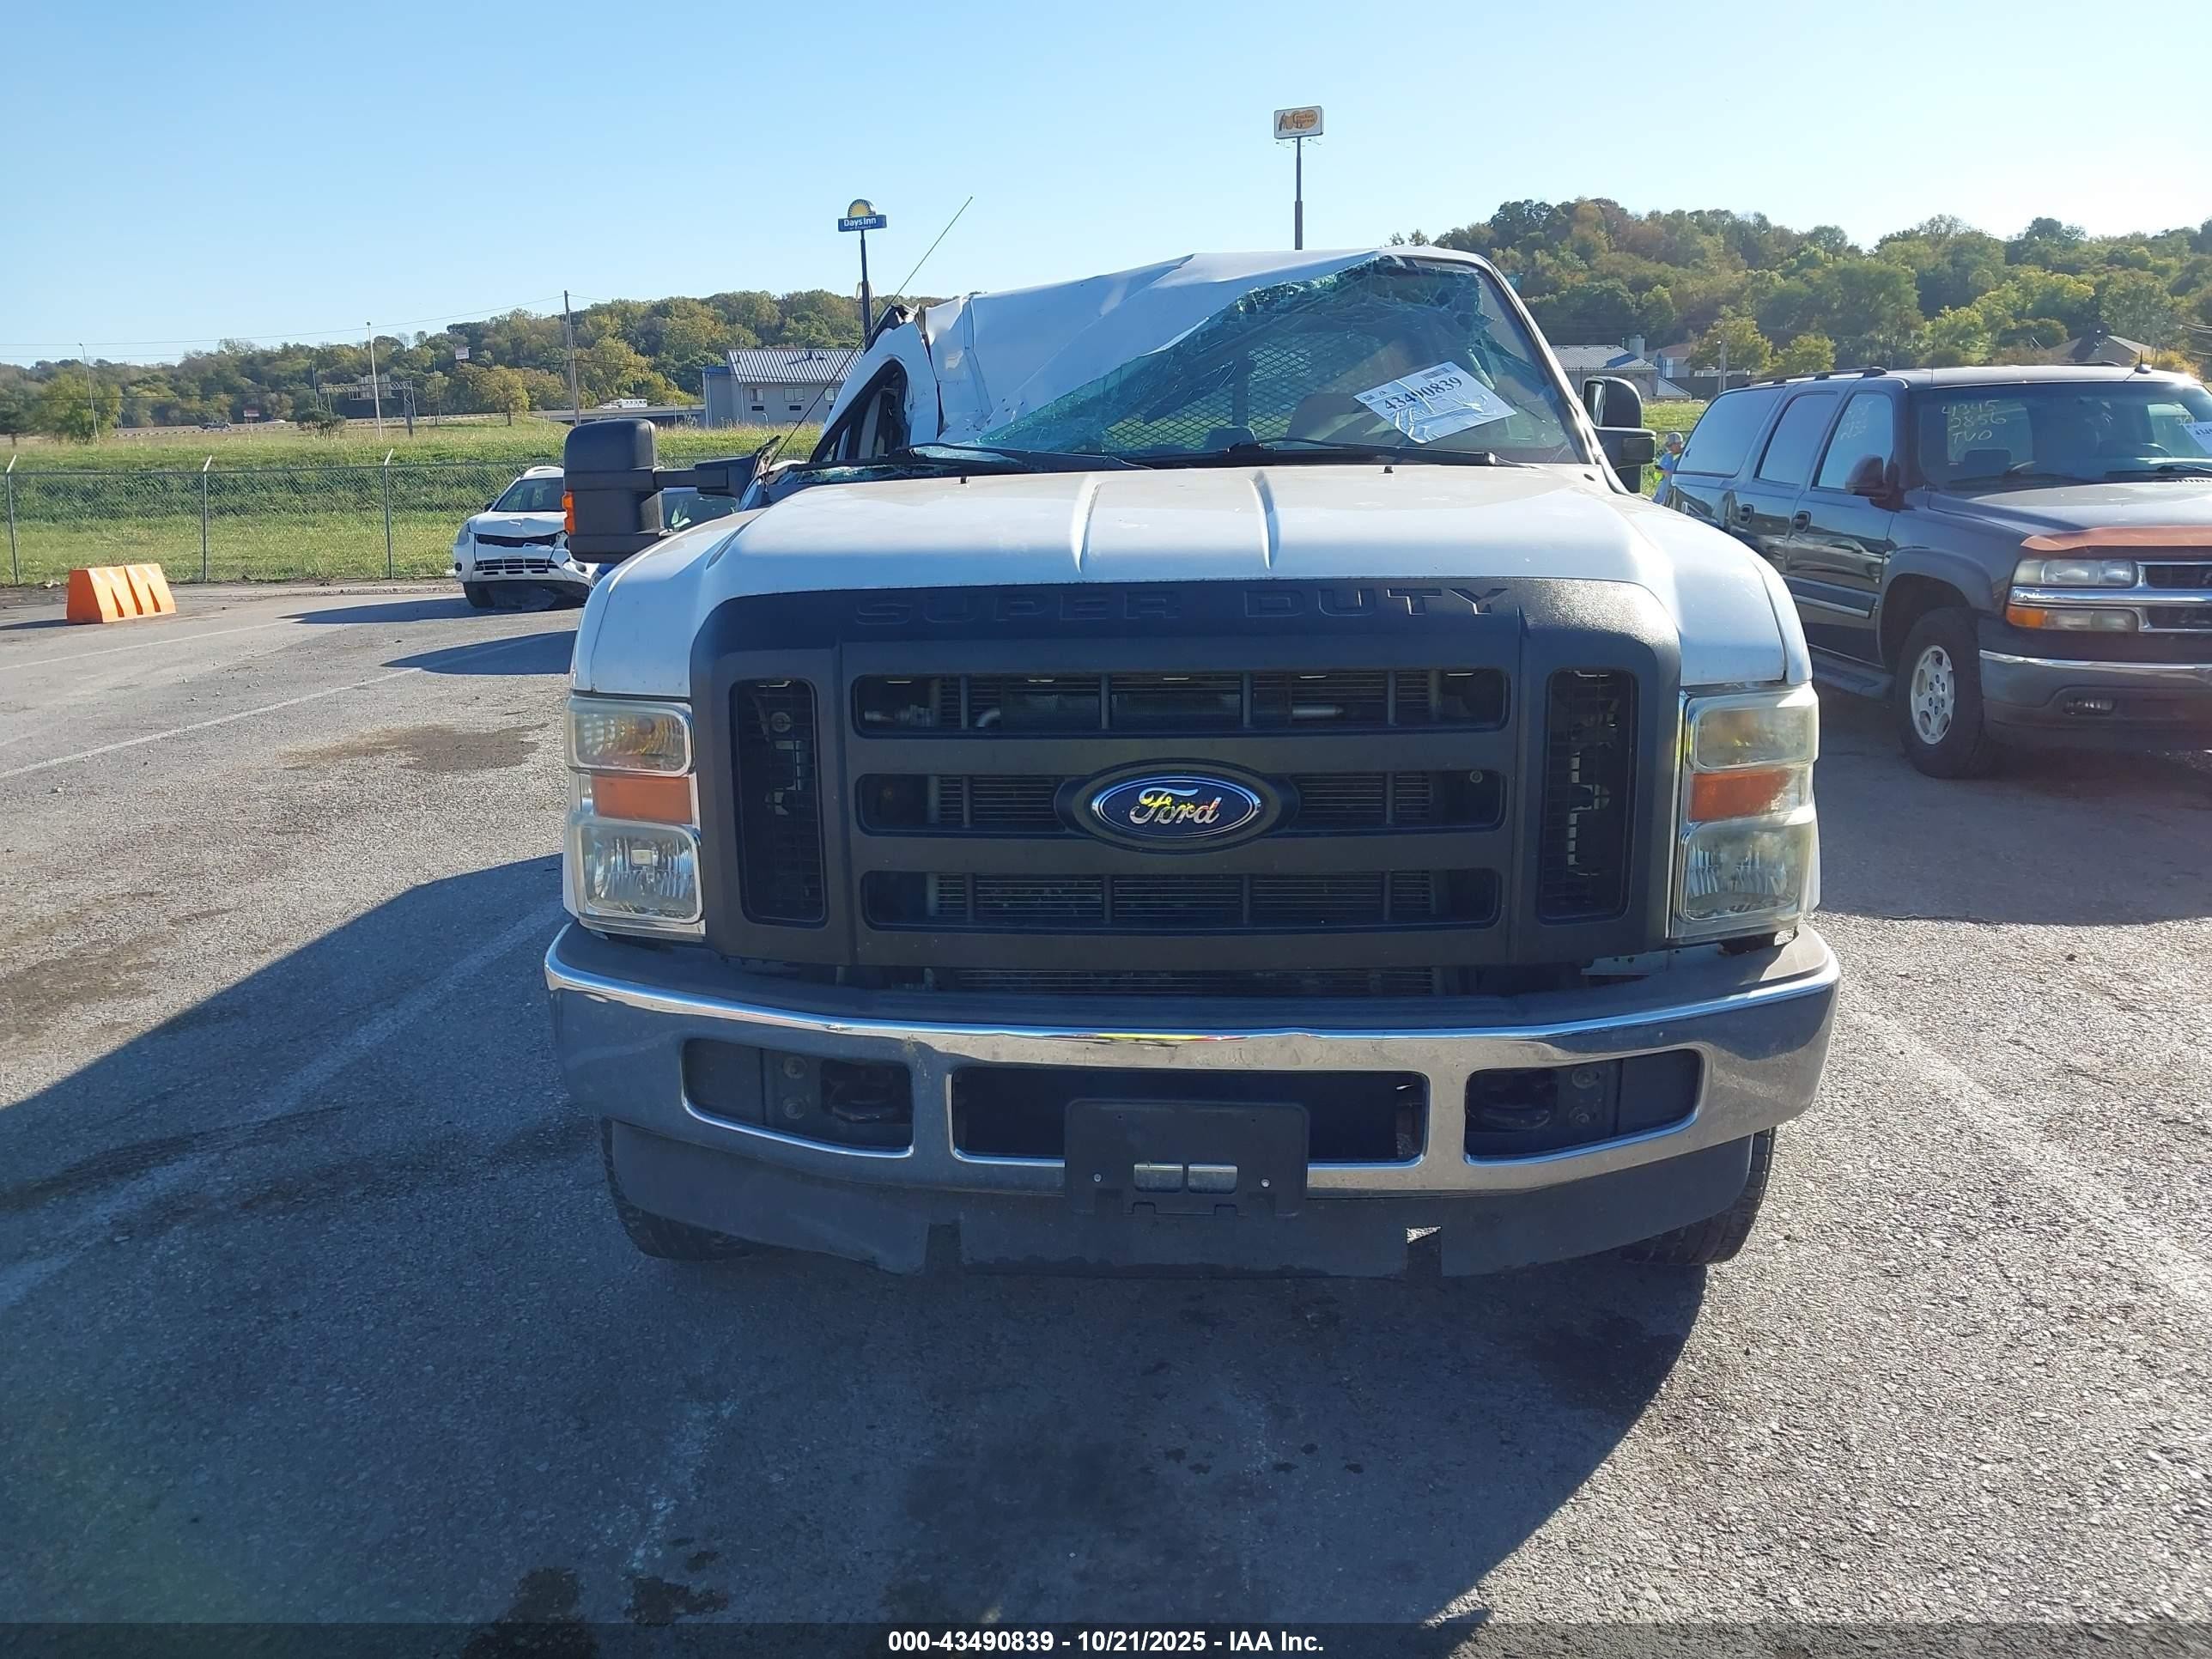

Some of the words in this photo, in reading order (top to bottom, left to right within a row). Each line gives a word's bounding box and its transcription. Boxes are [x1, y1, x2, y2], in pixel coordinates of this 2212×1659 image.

[1385, 376, 1462, 410] 43490839
[1941, 399, 2000, 416] 4345
[854, 591, 1182, 626] SUPER
[1243, 587, 1509, 617] DUTY
[1129, 787, 1223, 824] Ford
